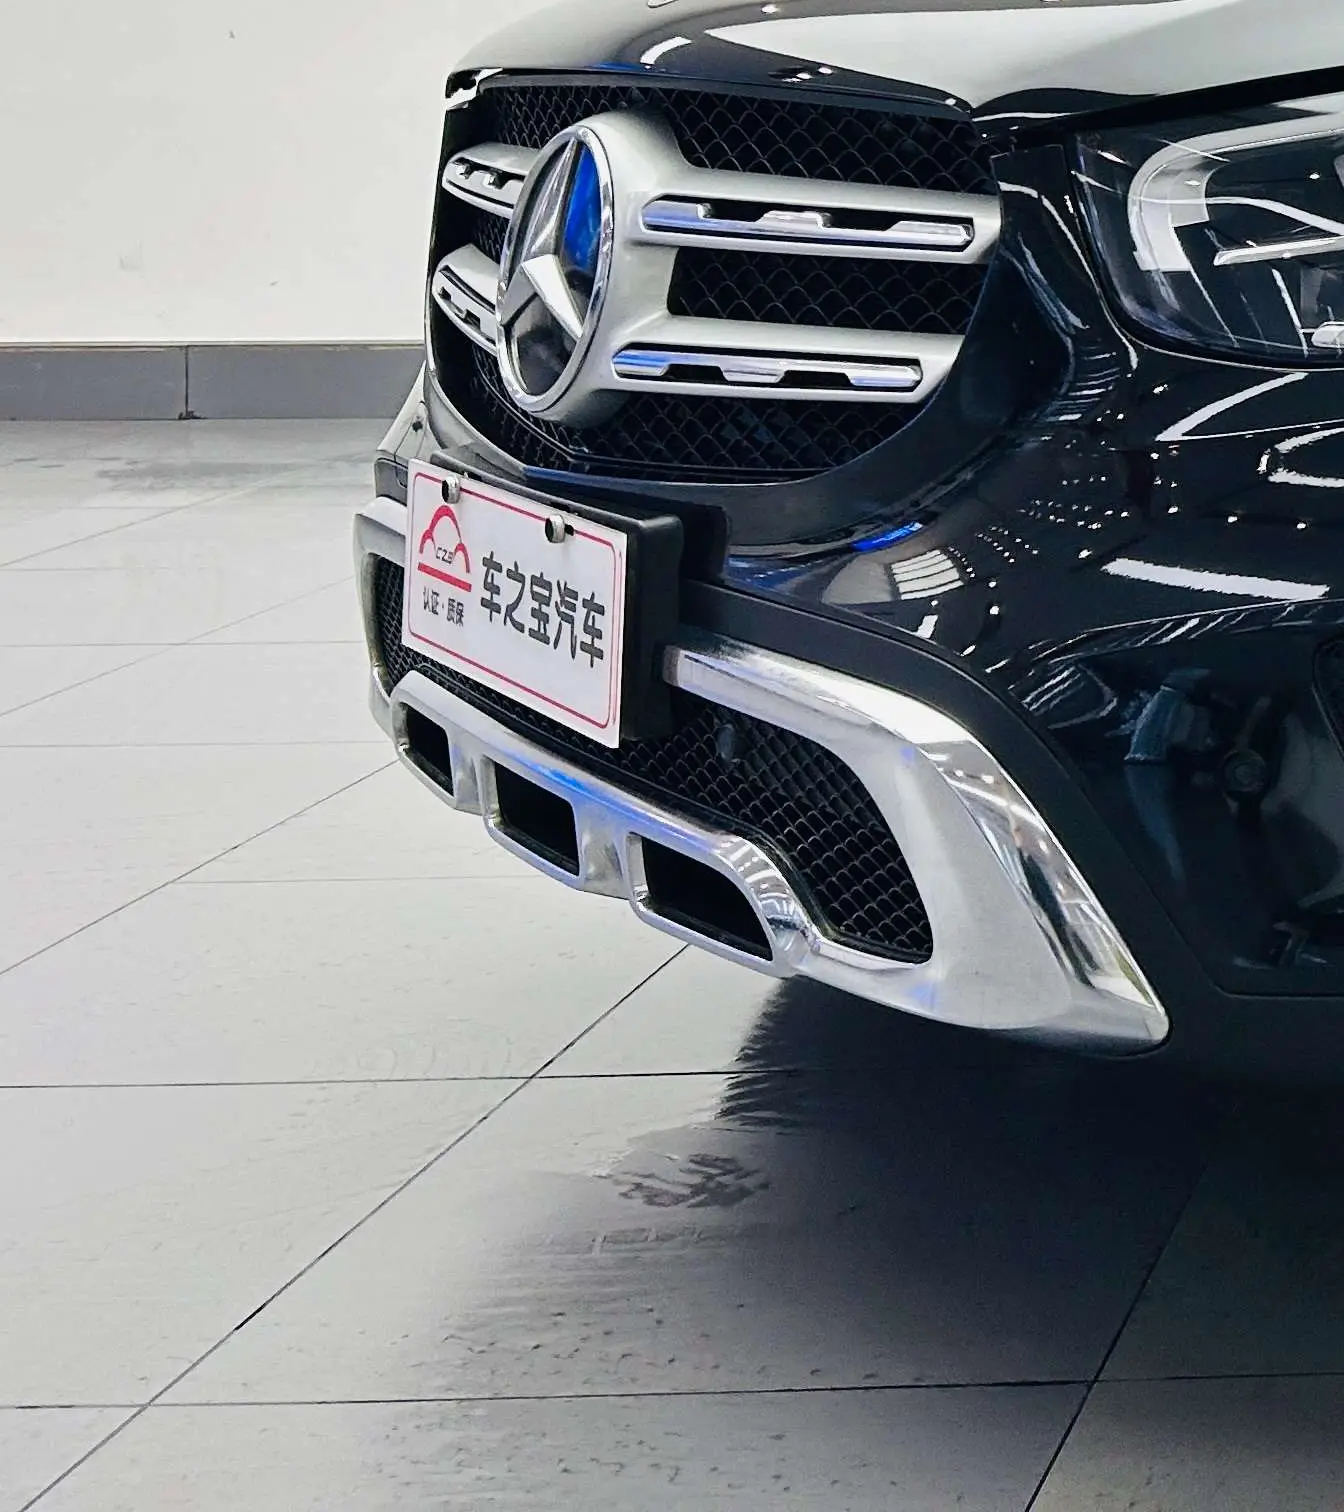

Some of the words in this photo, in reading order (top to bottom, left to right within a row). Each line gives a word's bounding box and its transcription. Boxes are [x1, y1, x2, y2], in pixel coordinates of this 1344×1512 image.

[480, 550, 605, 669] 车之宝汽车
